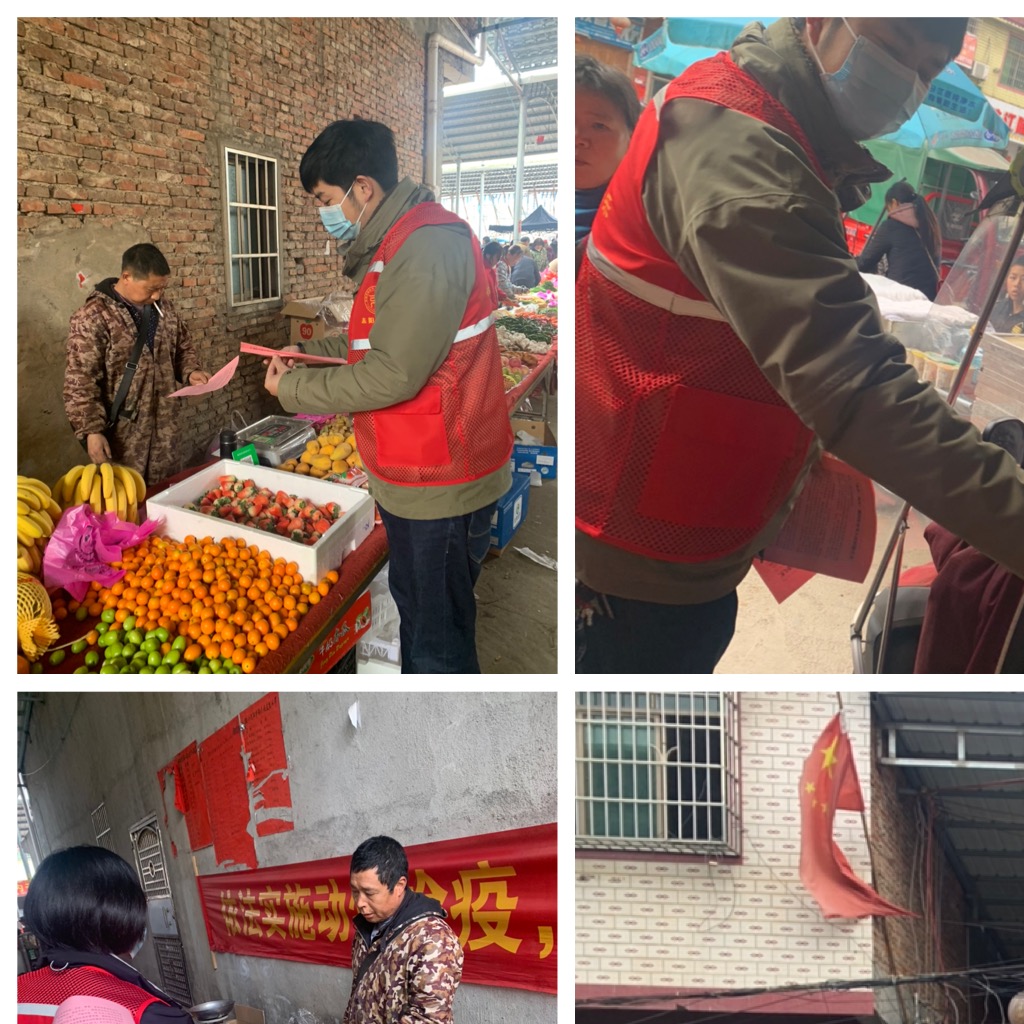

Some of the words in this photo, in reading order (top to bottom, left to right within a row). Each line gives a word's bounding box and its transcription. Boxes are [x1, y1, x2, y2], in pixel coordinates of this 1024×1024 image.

[301, 327, 312, 336] 90
[220, 860, 554, 959] 依法实施动疫，
